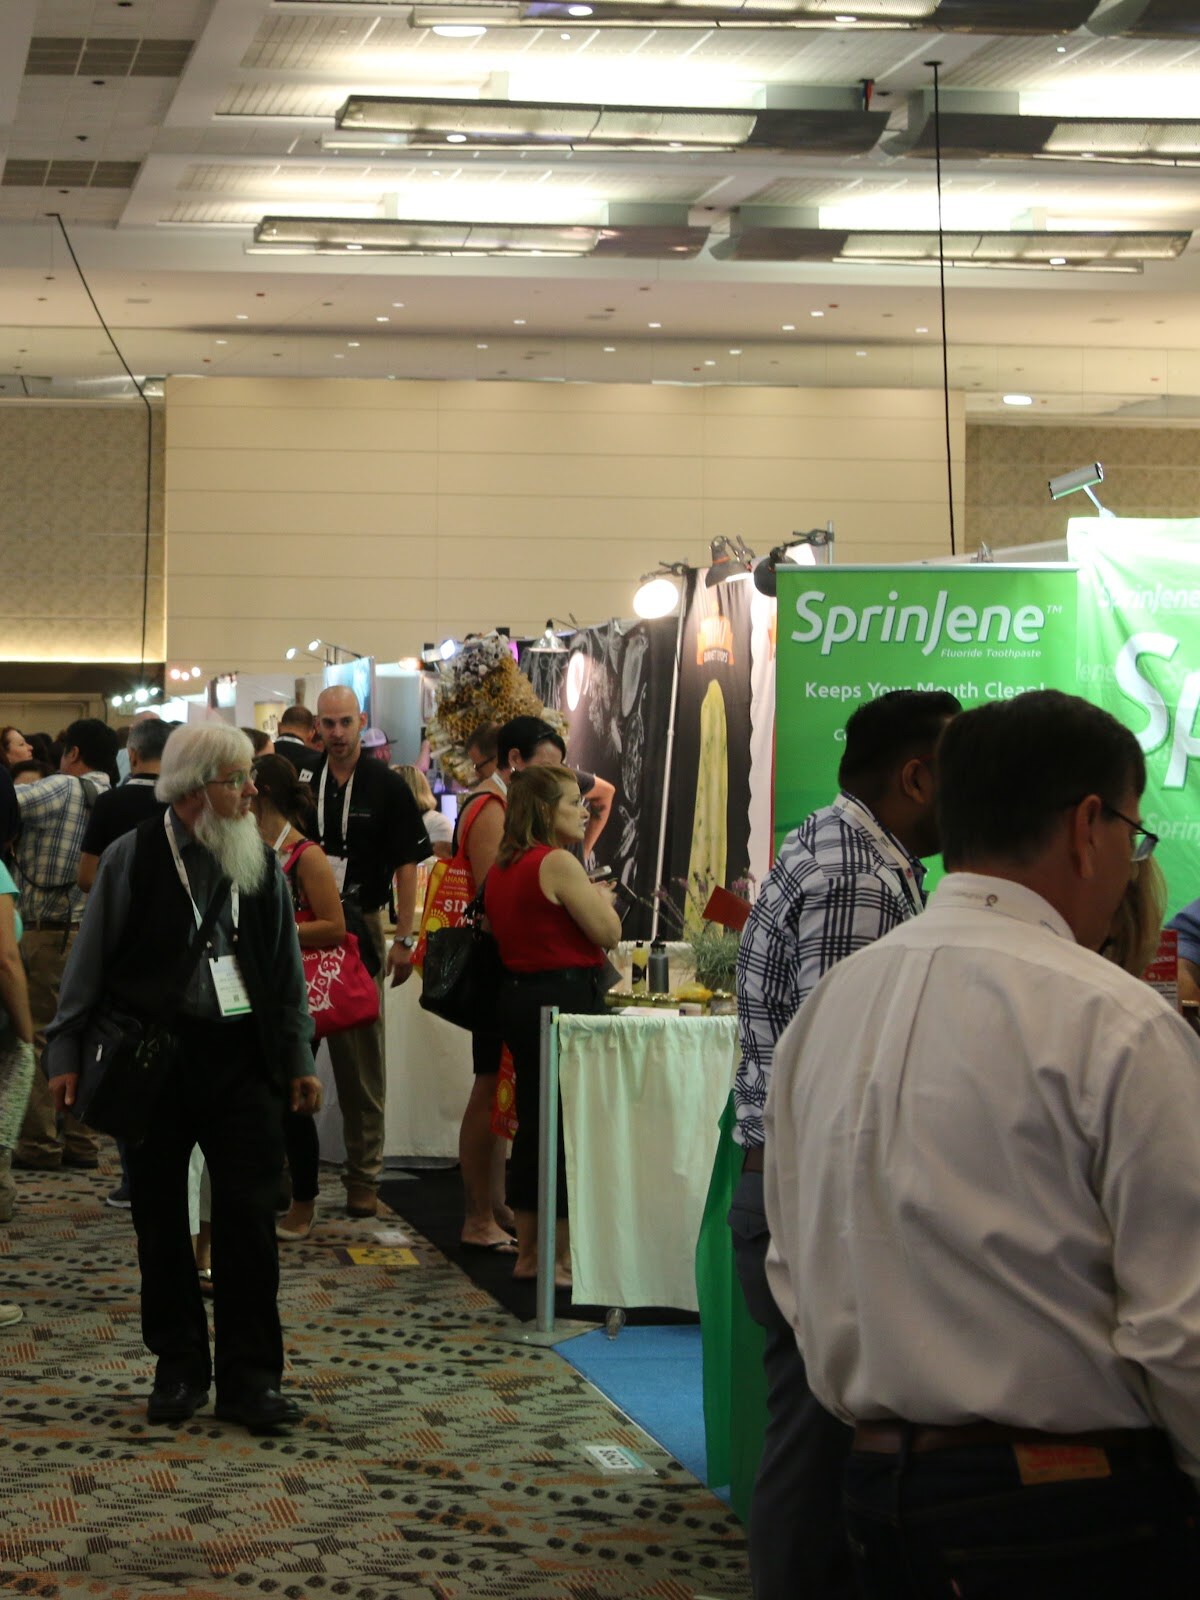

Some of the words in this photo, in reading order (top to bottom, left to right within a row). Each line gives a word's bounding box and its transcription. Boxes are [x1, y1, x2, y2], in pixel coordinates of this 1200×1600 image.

[791, 590, 1046, 657] SprinJene
[940, 648, 983, 659] Fluoride
[986, 648, 1042, 660] Toothpaste
[805, 682, 862, 703] Keeps
